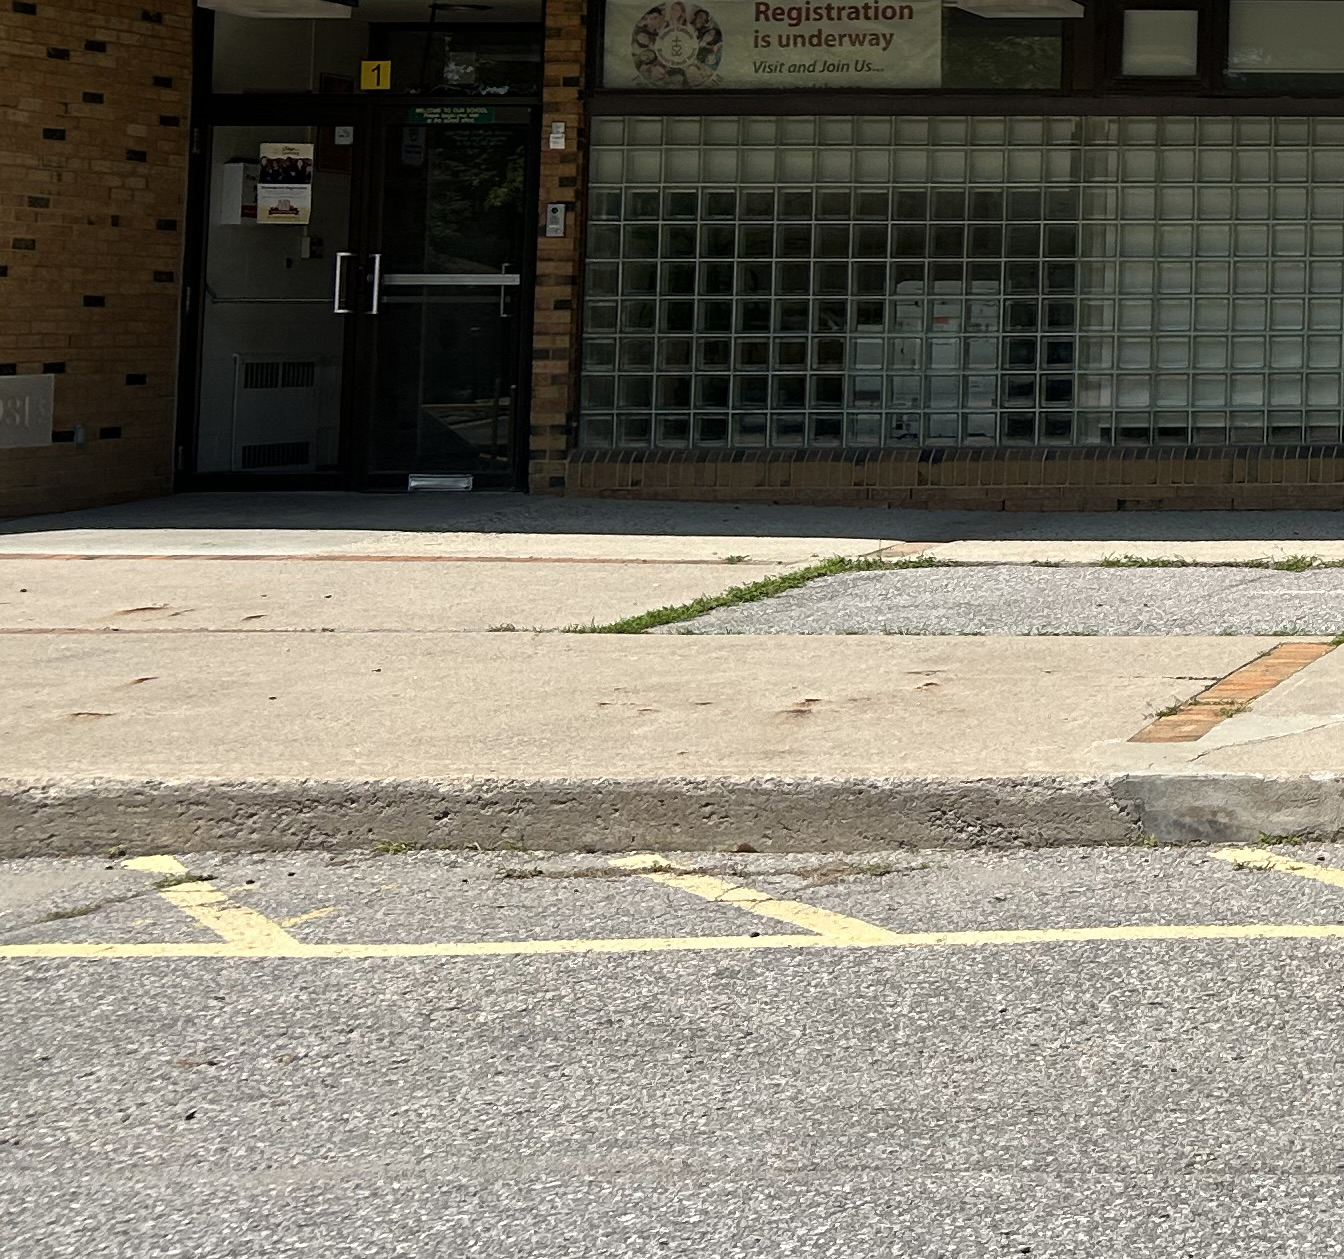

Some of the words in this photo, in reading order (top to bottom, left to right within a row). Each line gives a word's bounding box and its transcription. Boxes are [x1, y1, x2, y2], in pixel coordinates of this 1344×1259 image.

[754, 0, 914, 28] Registration
[754, 29, 771, 49] is
[778, 28, 895, 52] underway
[371, 63, 381, 87] 1
[753, 60, 785, 74] Visit
[787, 61, 817, 74] and
[819, 60, 850, 73] Join
